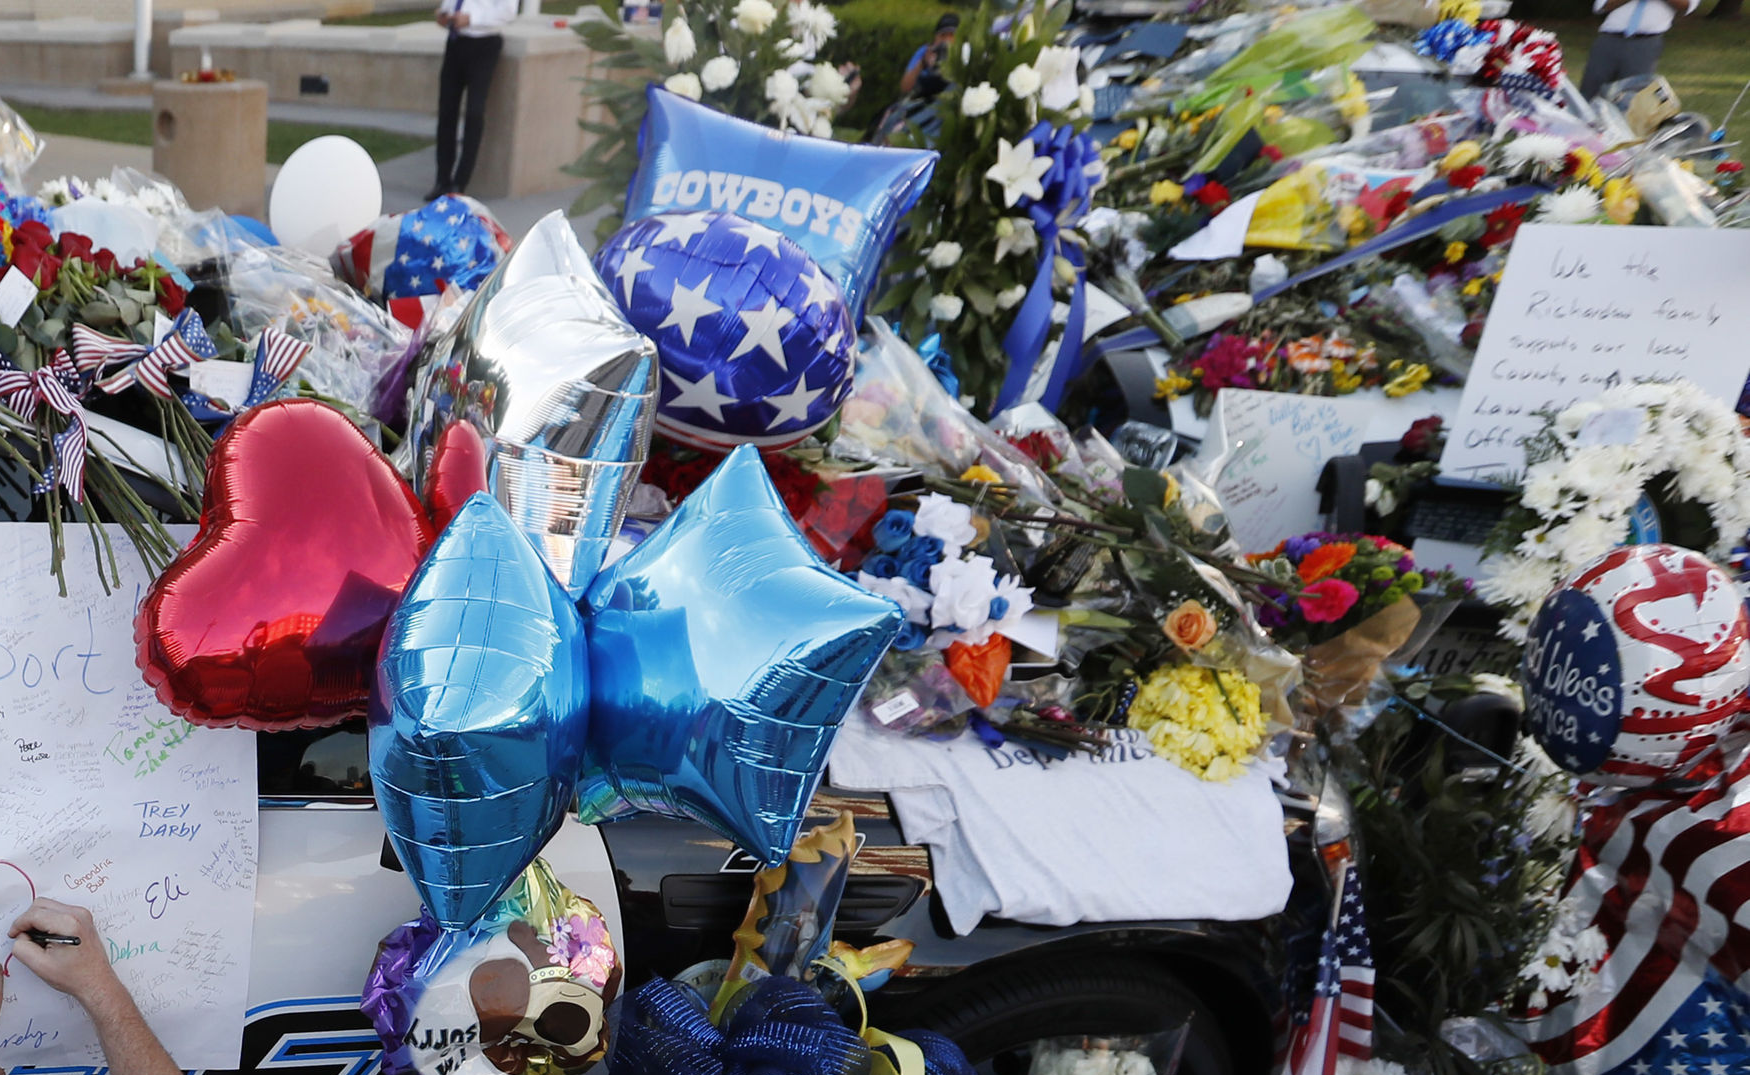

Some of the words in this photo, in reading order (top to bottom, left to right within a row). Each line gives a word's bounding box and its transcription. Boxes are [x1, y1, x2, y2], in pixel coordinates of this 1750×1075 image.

[651, 170, 863, 246] COWBOYS
[1553, 248, 1592, 280] We
[1622, 253, 1660, 282] the
[1592, 342, 1626, 354] our
[1475, 396, 1520, 416] Law
[1546, 641, 1614, 717] bless
[133, 800, 191, 820] TREY
[106, 937, 164, 965] Debra
